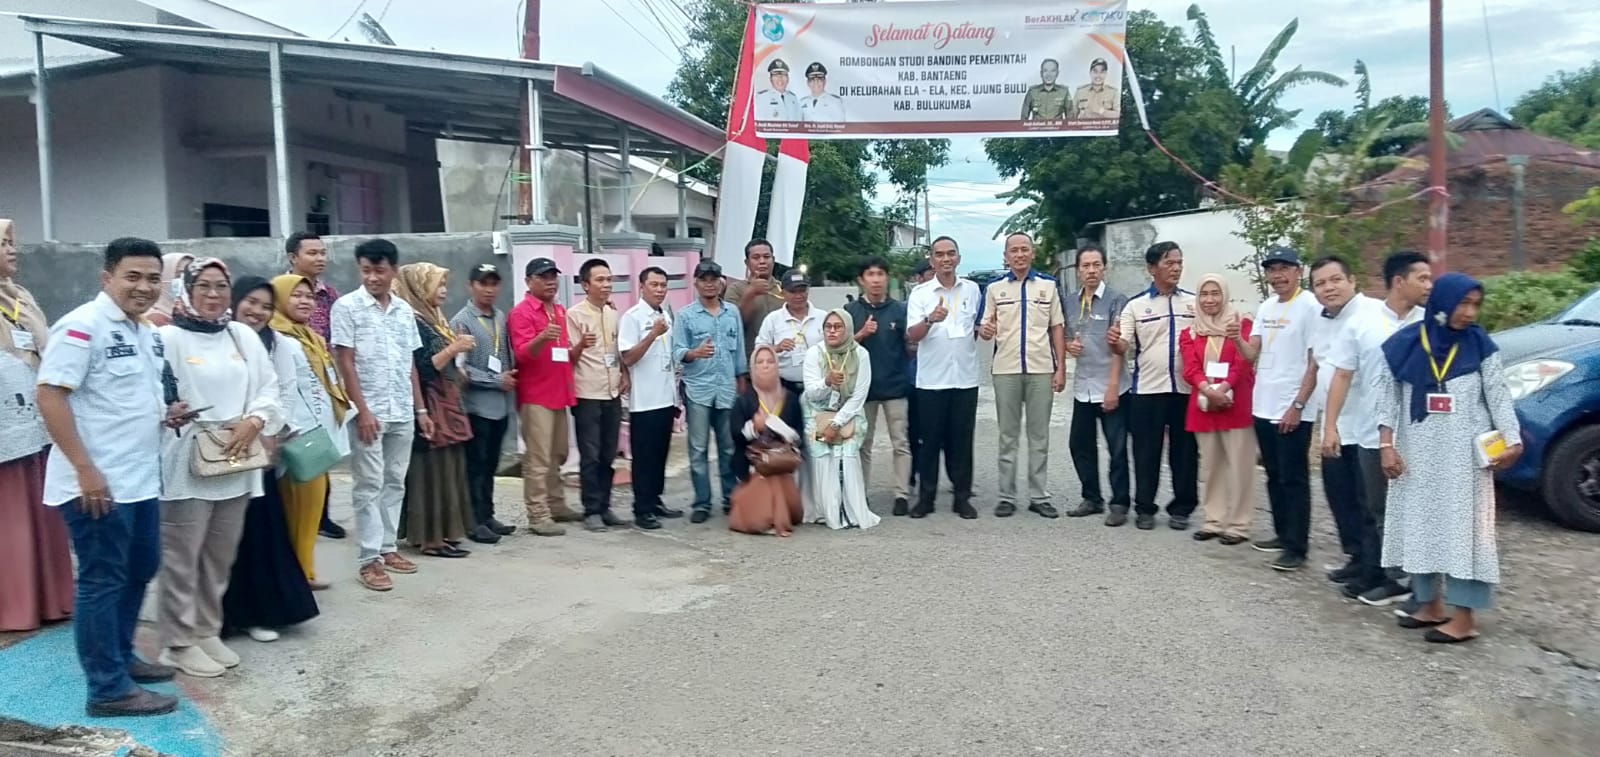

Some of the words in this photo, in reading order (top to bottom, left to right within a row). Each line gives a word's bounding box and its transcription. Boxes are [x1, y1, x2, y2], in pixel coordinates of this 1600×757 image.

[865, 22, 931, 48] Selamat
[933, 21, 996, 49] Datang
[839, 56, 897, 67] ROMBONGAN
[899, 55, 925, 67] STUDI
[927, 54, 967, 66] BANDING
[969, 53, 1027, 65] PEMERINTAH
[898, 71, 918, 81] KAB.
[921, 70, 967, 81] BANTAENG
[839, 86, 848, 97] DI
[851, 85, 901, 97] KELURAHAN
[904, 85, 920, 96] ELA
[950, 84, 970, 95] KEC.
[972, 84, 1001, 95] UJUNG
[1004, 83, 1027, 94] BULU
[893, 100, 914, 111] KAB.
[916, 99, 971, 111] BULUKUMBA
